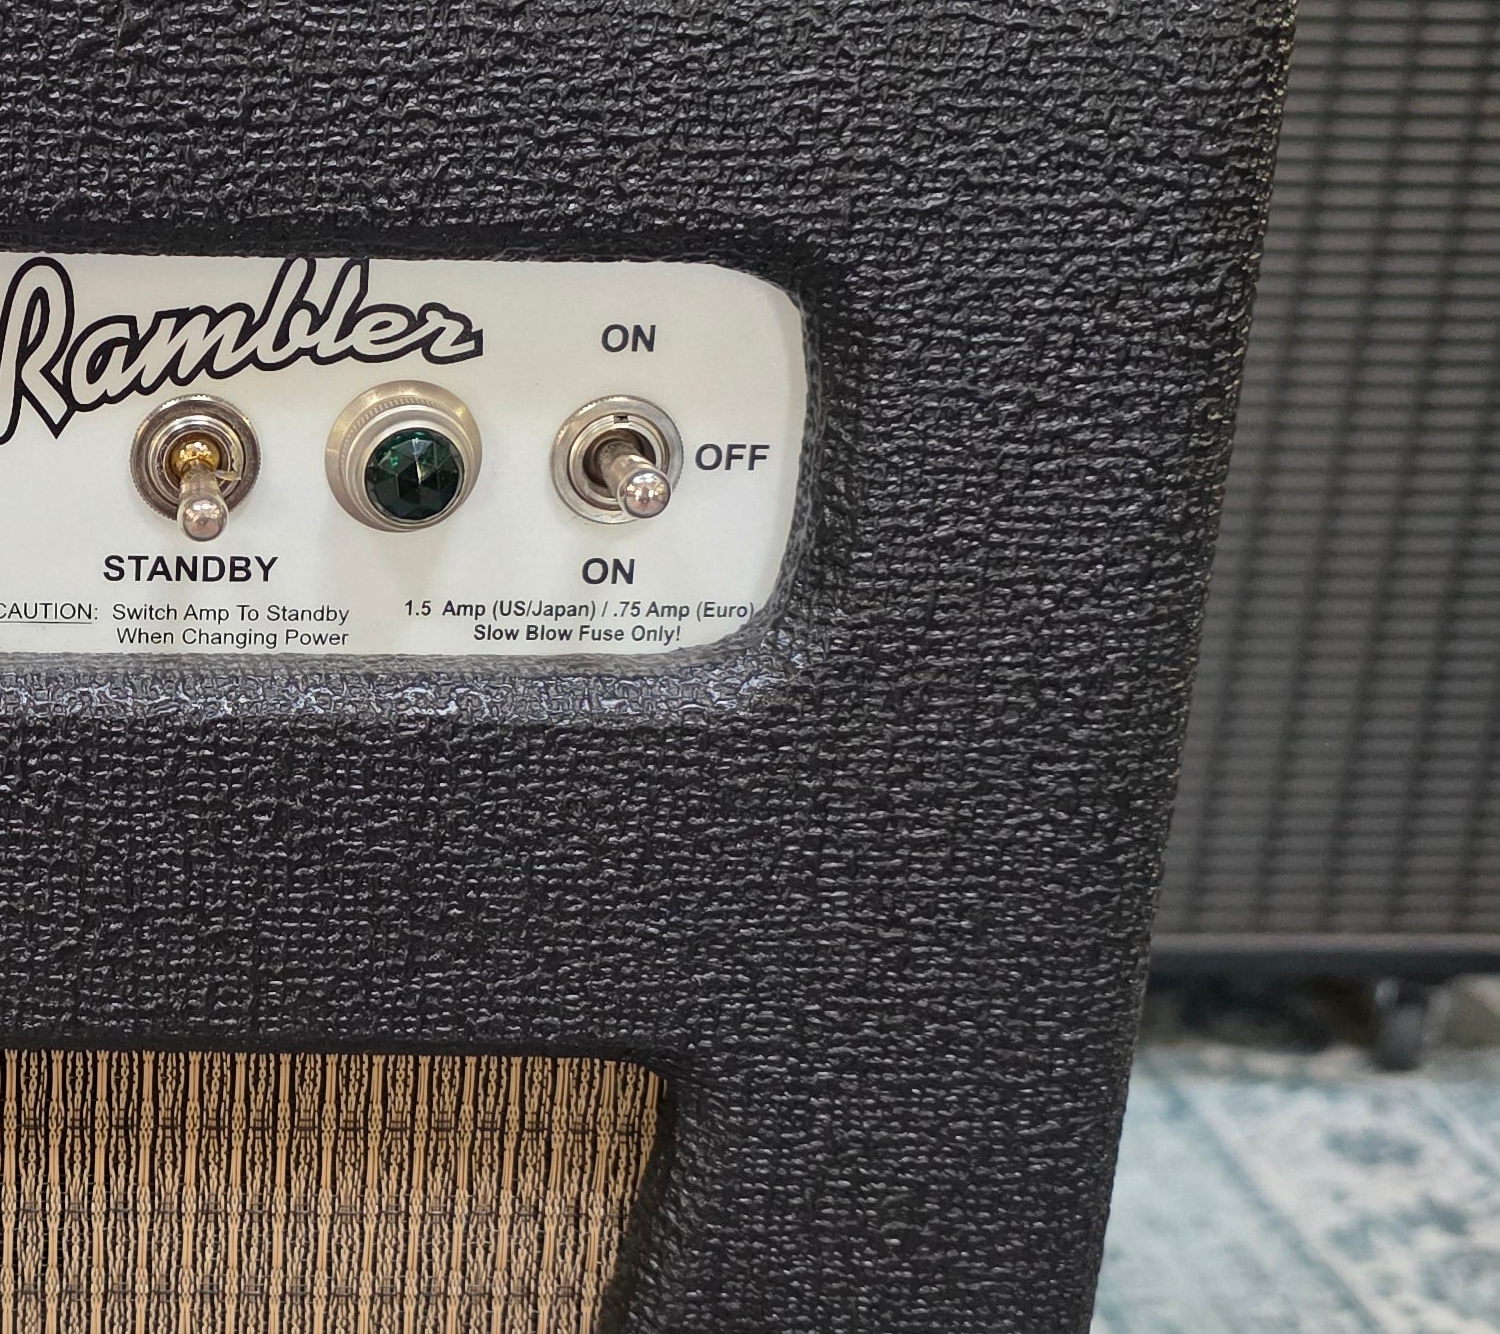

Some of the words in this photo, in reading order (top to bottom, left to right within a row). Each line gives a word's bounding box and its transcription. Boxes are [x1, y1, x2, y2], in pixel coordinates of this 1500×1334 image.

[601, 323, 656, 353] ON
[695, 443, 770, 471] OFF
[103, 554, 279, 583] STANDBY
[582, 557, 636, 585] ON
[112, 603, 178, 622] Switch
[183, 603, 230, 625] Amp
[236, 603, 260, 622] To
[266, 604, 350, 626] Standby
[404, 599, 432, 617] 1.5
[442, 600, 486, 620] Amp
[492, 600, 596, 620] (US/Japan)
[601, 600, 609, 618] /
[613, 601, 641, 618] .75
[645, 601, 690, 620] Amp
[696, 601, 755, 622] (Euro)
[116, 627, 174, 645] When
[182, 627, 277, 650] Changing
[285, 628, 350, 646] Power
[473, 624, 520, 641] Slow
[525, 624, 574, 641] Blow
[578, 625, 625, 642] Fuse
[631, 625, 681, 646] Only!
